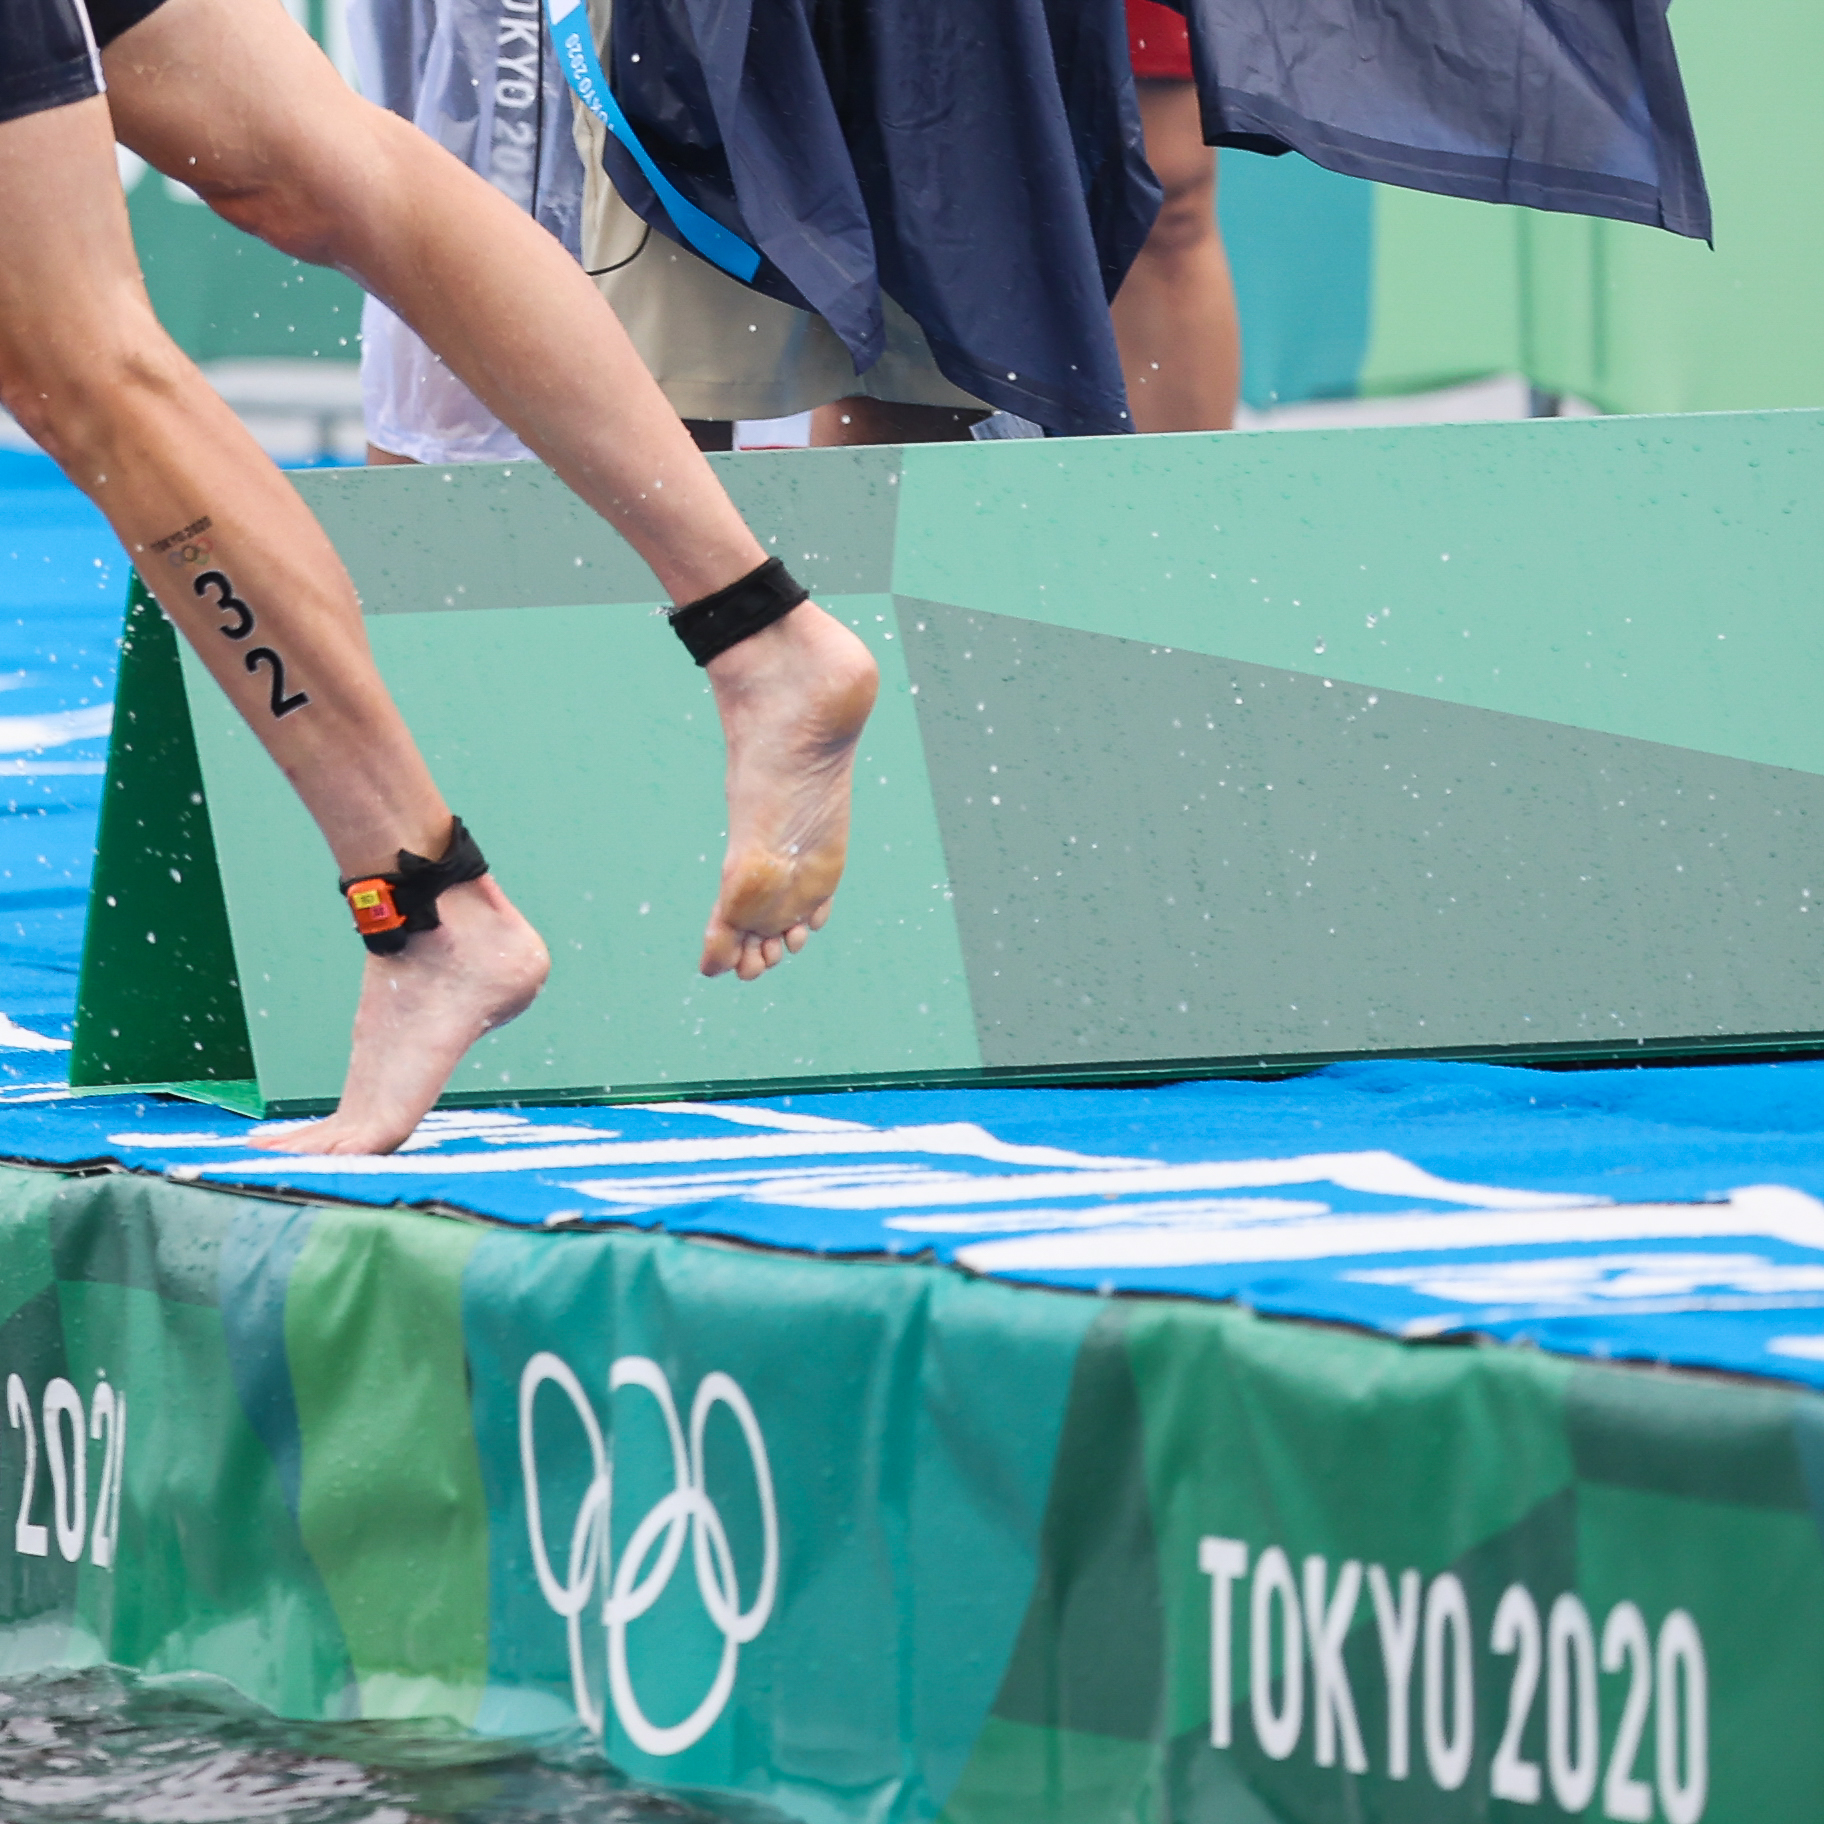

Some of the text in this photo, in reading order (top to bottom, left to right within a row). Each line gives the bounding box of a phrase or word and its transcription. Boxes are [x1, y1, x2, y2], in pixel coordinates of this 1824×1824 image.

[193, 570, 310, 718] 32
[1199, 1535, 1710, 1824] TOKYO 2020
